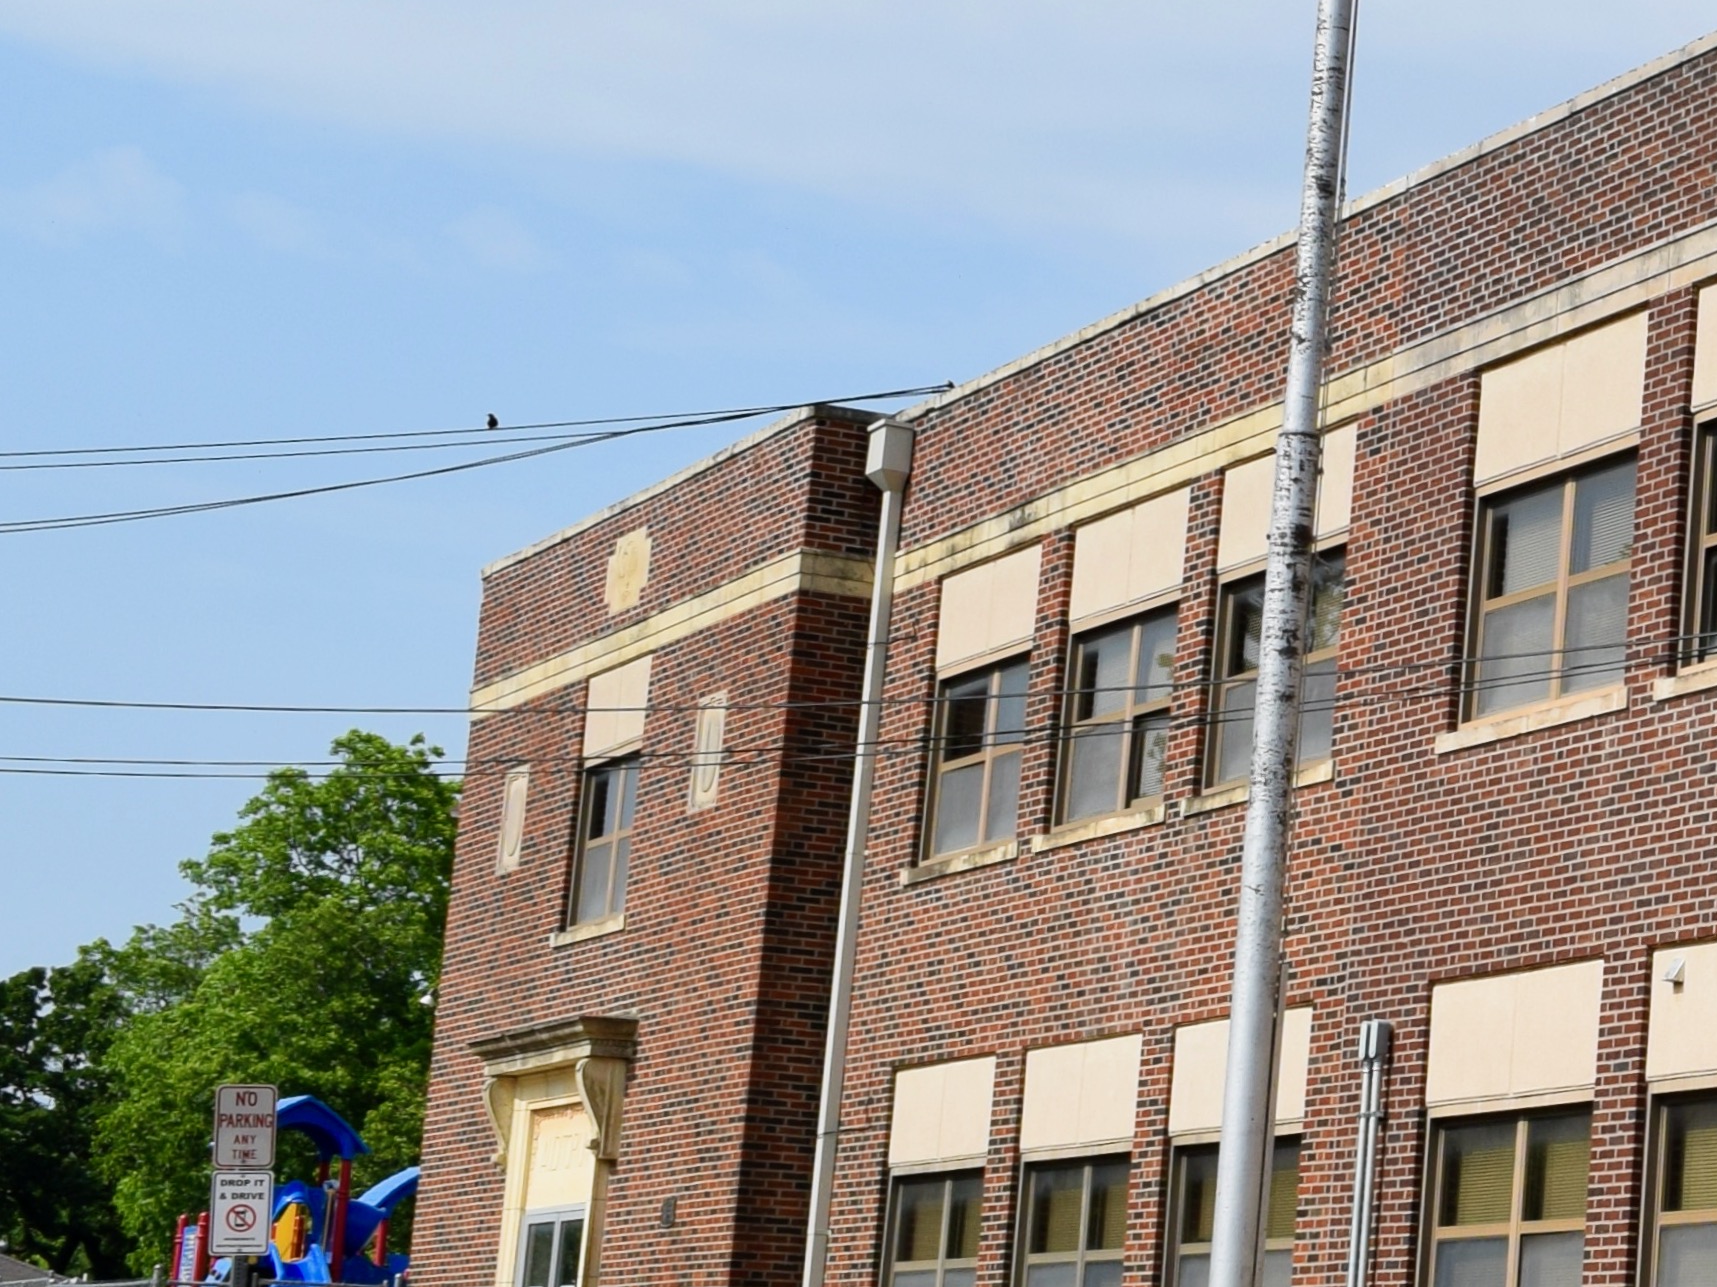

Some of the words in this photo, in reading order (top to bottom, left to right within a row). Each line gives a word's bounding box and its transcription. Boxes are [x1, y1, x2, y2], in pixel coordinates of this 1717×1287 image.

[235, 1091, 258, 1107] NO
[219, 1113, 273, 1128] PARKING
[233, 1134, 257, 1145] ANY
[232, 1149, 257, 1160] TIME
[220, 1179, 251, 1187] DROP
[254, 1179, 265, 1187] IT
[219, 1192, 227, 1200] &
[231, 1192, 264, 1200] DRIVE
